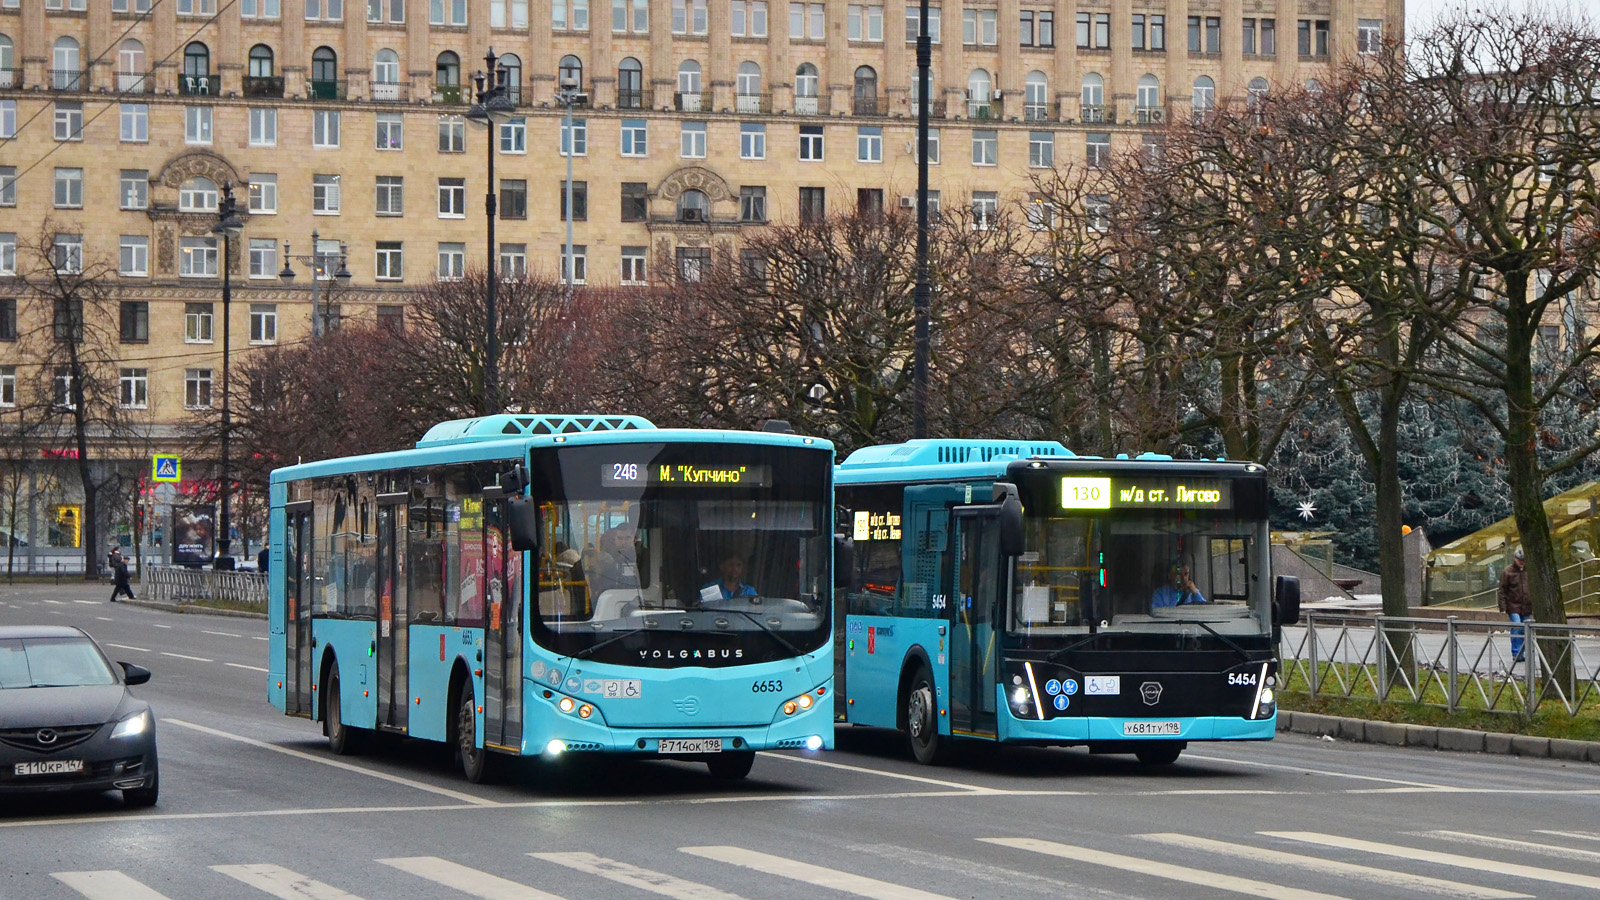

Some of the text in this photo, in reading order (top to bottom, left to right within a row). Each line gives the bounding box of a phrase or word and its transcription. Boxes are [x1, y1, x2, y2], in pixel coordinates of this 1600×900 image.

[613, 463, 637, 480] 246
[660, 465, 746, 482] М. "Купчино"
[1072, 487, 1100, 500] 130
[1120, 485, 1220, 503] ж/д ст. Лигово
[931, 594, 947, 609] 5454
[462, 630, 473, 645] 6653
[639, 649, 743, 659] VOLGABUS
[752, 680, 783, 693] 6653
[1227, 672, 1256, 686] 5454
